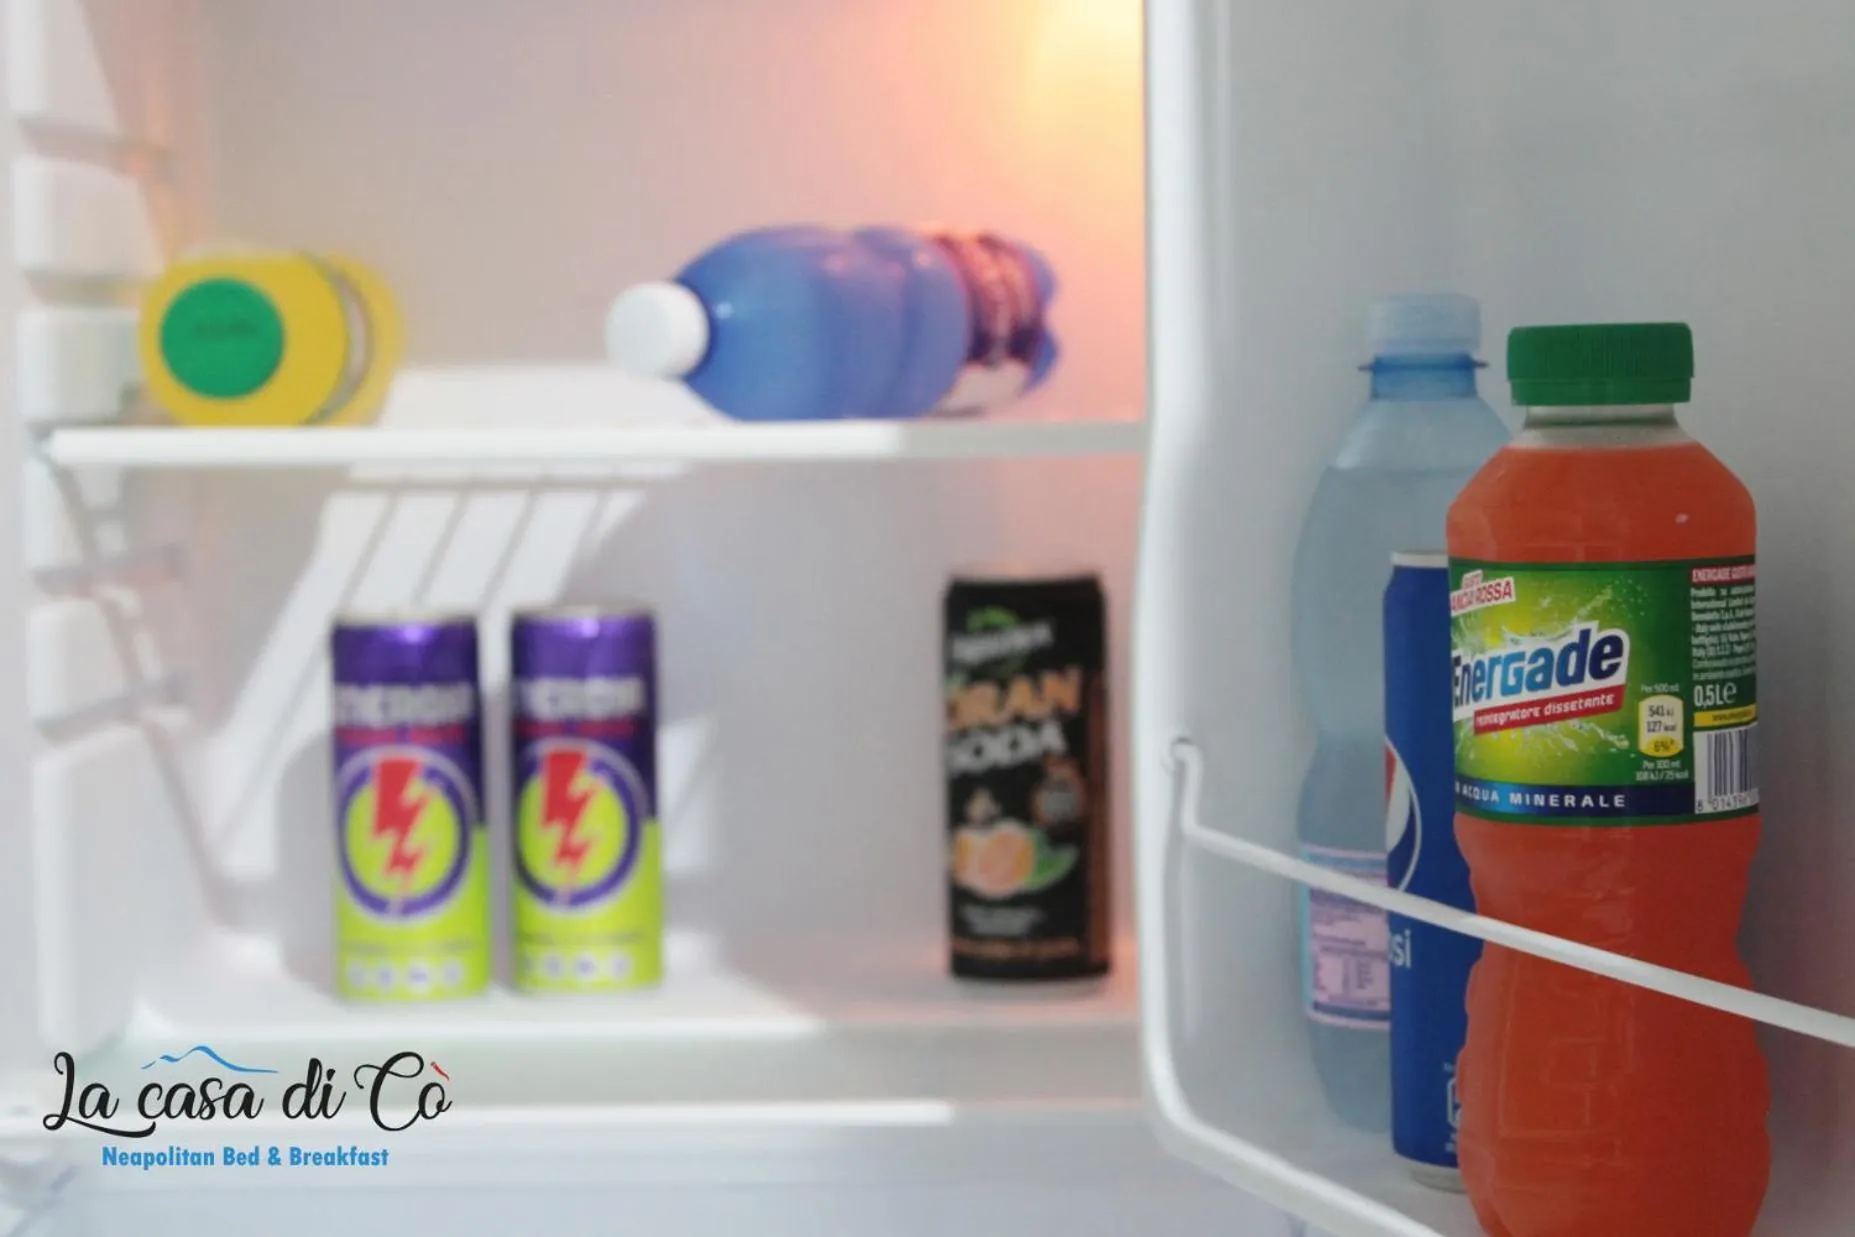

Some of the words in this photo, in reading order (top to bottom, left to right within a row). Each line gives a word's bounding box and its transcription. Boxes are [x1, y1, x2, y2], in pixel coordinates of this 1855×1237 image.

[1543, 693, 1616, 716] dissetante
[1647, 705, 1665, 718] 541
[1462, 785, 1500, 804] ACQUA
[1509, 792, 1626, 808] MINERALE
